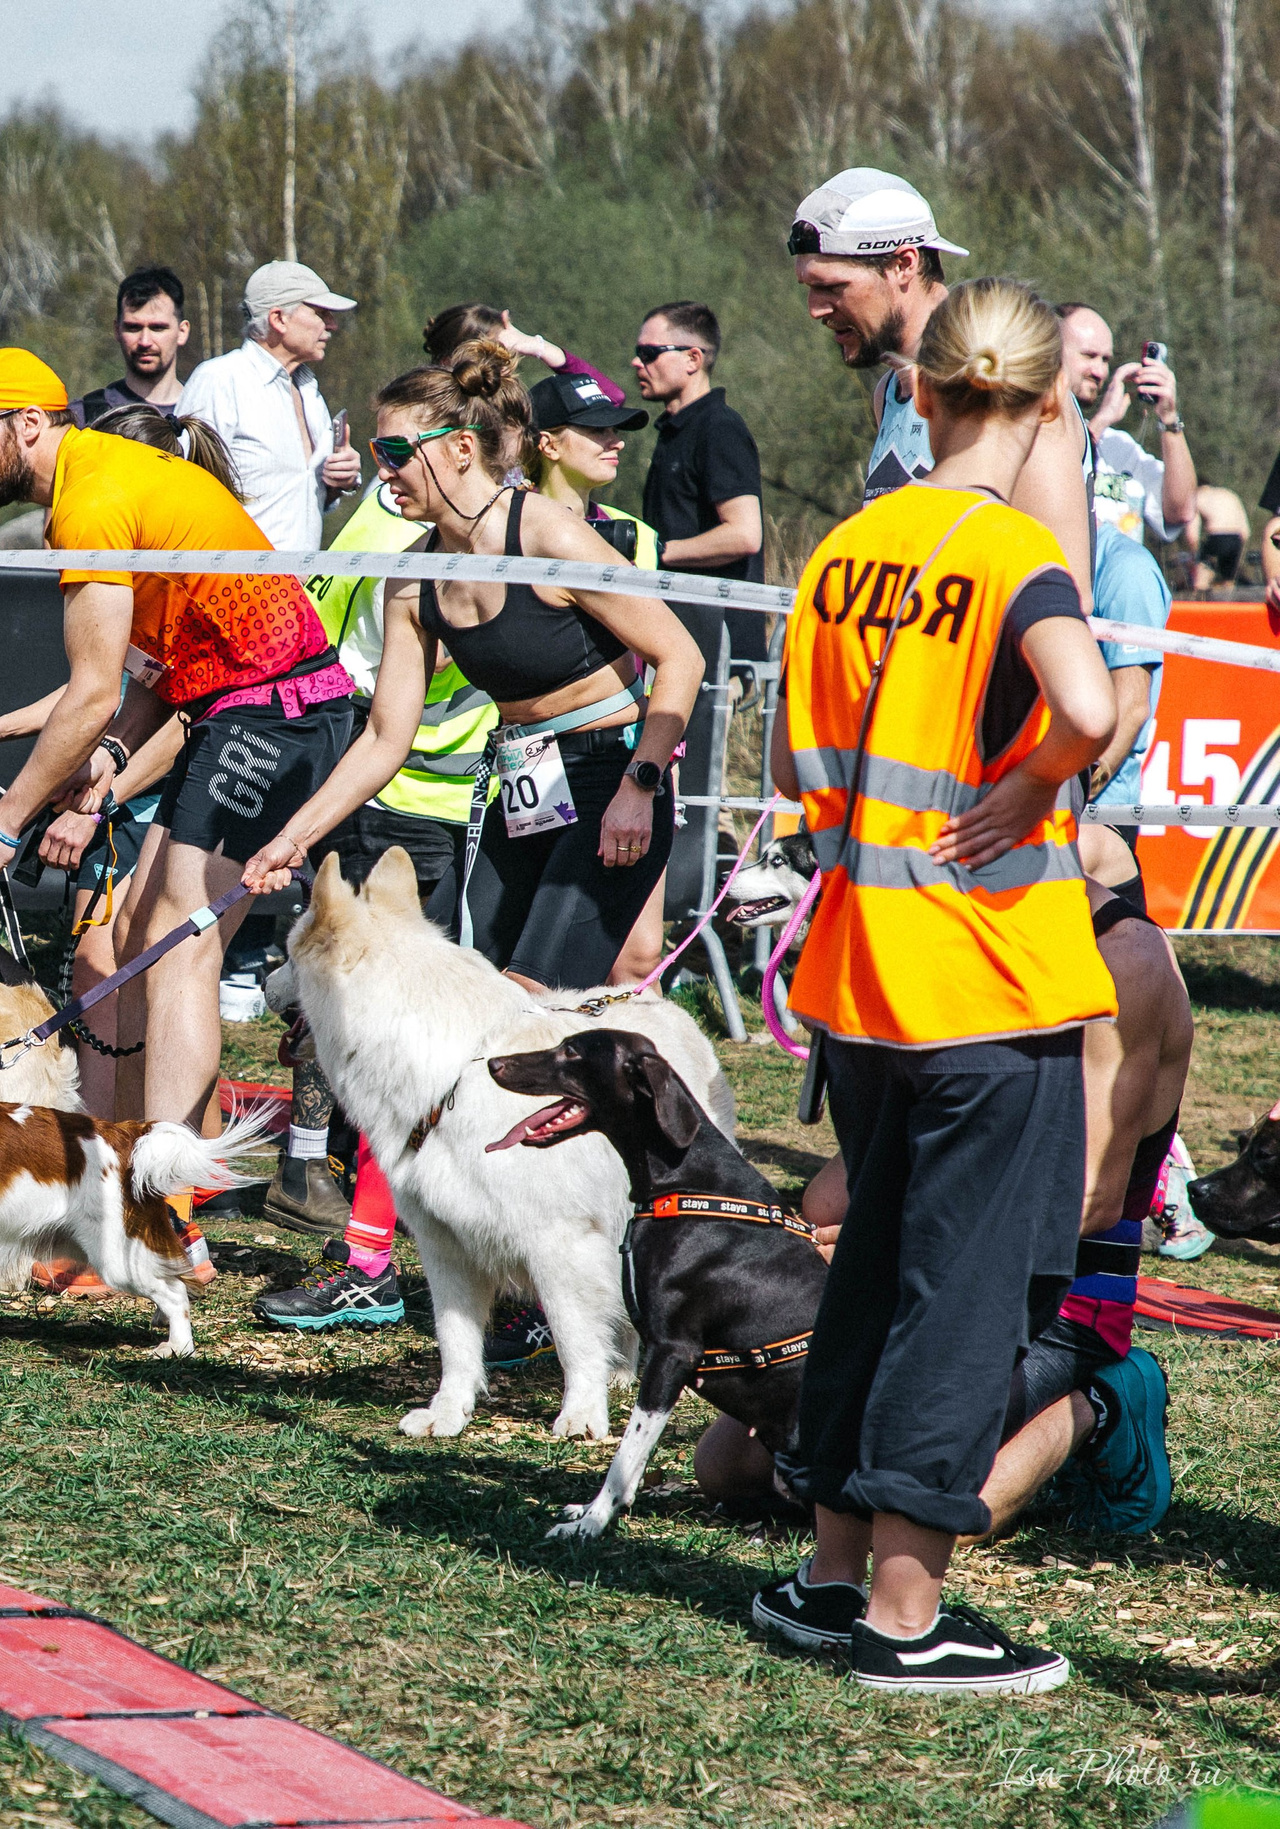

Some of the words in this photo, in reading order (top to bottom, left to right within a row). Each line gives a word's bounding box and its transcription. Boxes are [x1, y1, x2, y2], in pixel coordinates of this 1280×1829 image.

[813, 558, 975, 644] СУДЬЯ
[502, 775, 539, 814] 20
[681, 1198, 709, 1210] staya
[720, 1201, 748, 1214] staya
[715, 1354, 741, 1365] staya
[781, 1340, 808, 1356] staya
